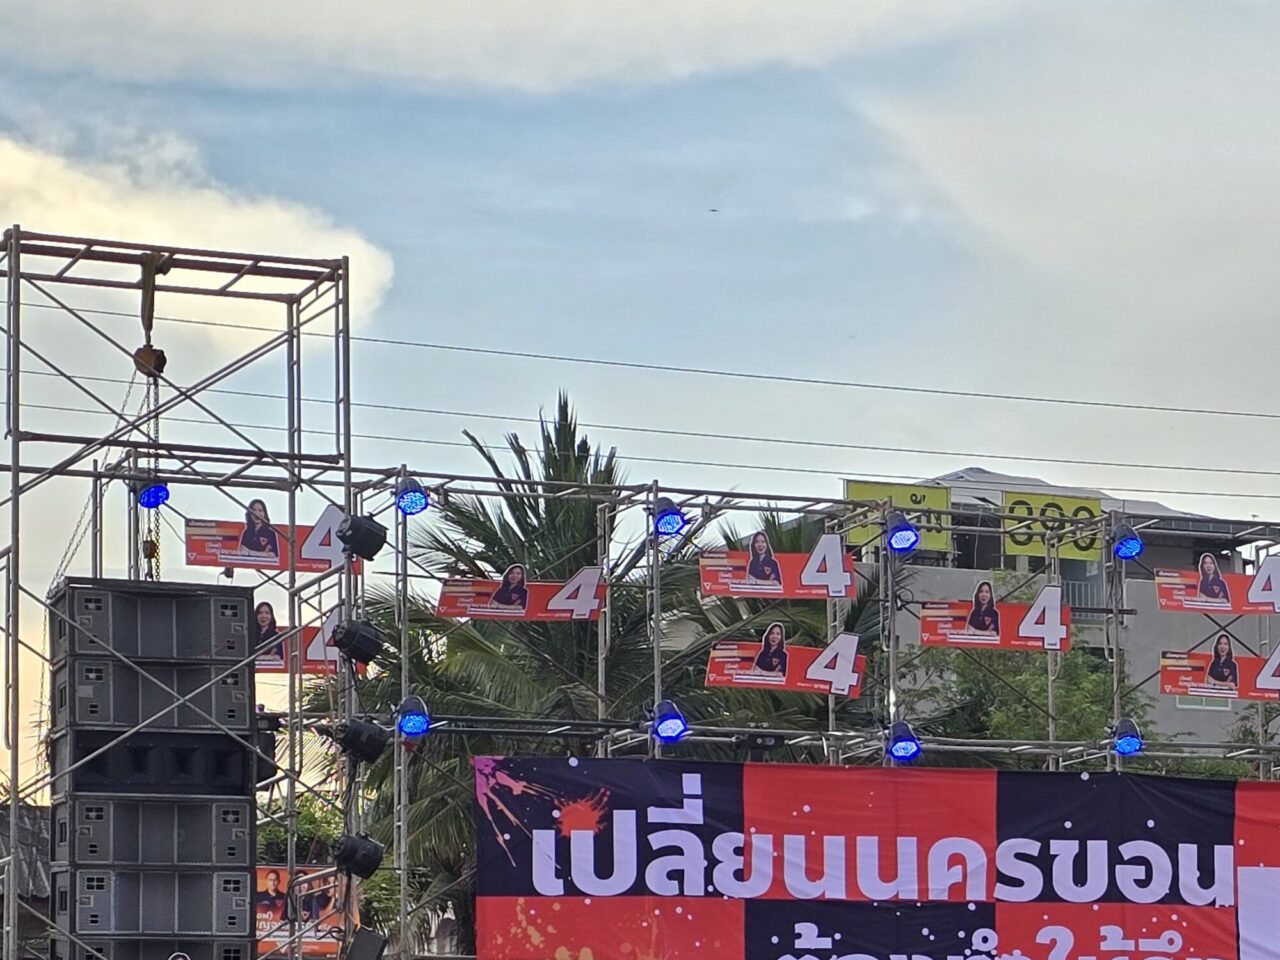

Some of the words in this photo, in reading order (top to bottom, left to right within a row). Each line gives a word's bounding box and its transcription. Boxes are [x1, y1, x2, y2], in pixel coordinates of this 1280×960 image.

[302, 504, 357, 569] 4
[801, 534, 851, 597] 4
[547, 566, 602, 619] 4
[1018, 586, 1067, 649] 4
[806, 633, 859, 695] 4
